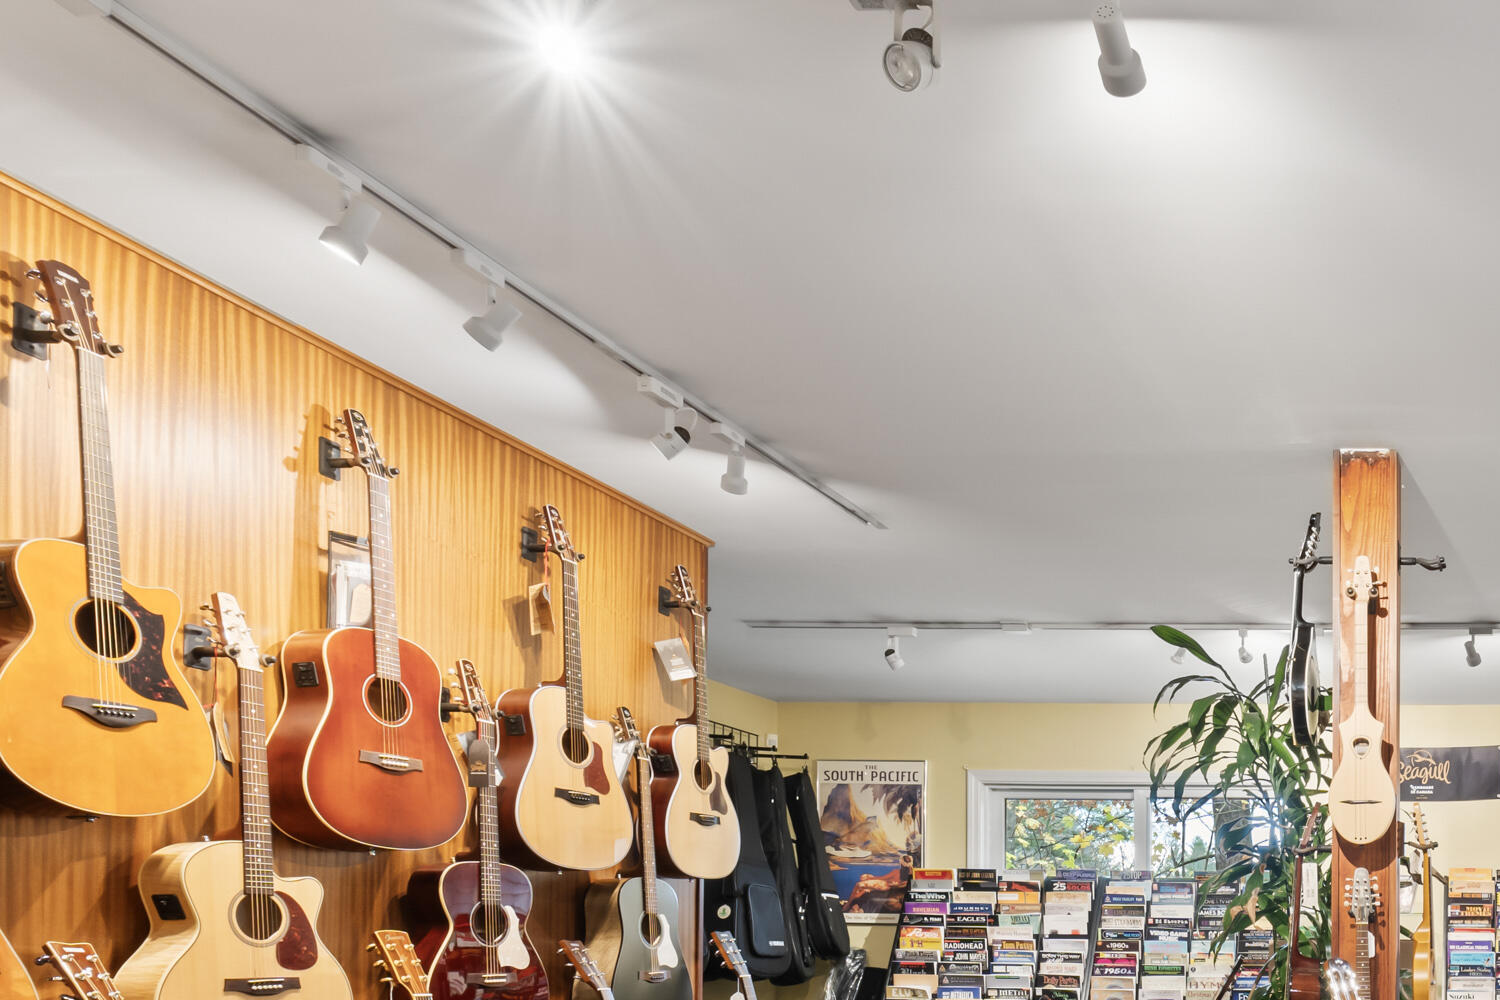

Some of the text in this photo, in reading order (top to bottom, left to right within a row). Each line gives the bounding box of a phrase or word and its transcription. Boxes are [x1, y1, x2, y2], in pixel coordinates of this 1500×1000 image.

[824, 771, 919, 782] SOUTH PACIFIC
[1053, 883, 1066, 891] 25
[944, 942, 983, 950] RADIOHEAD
